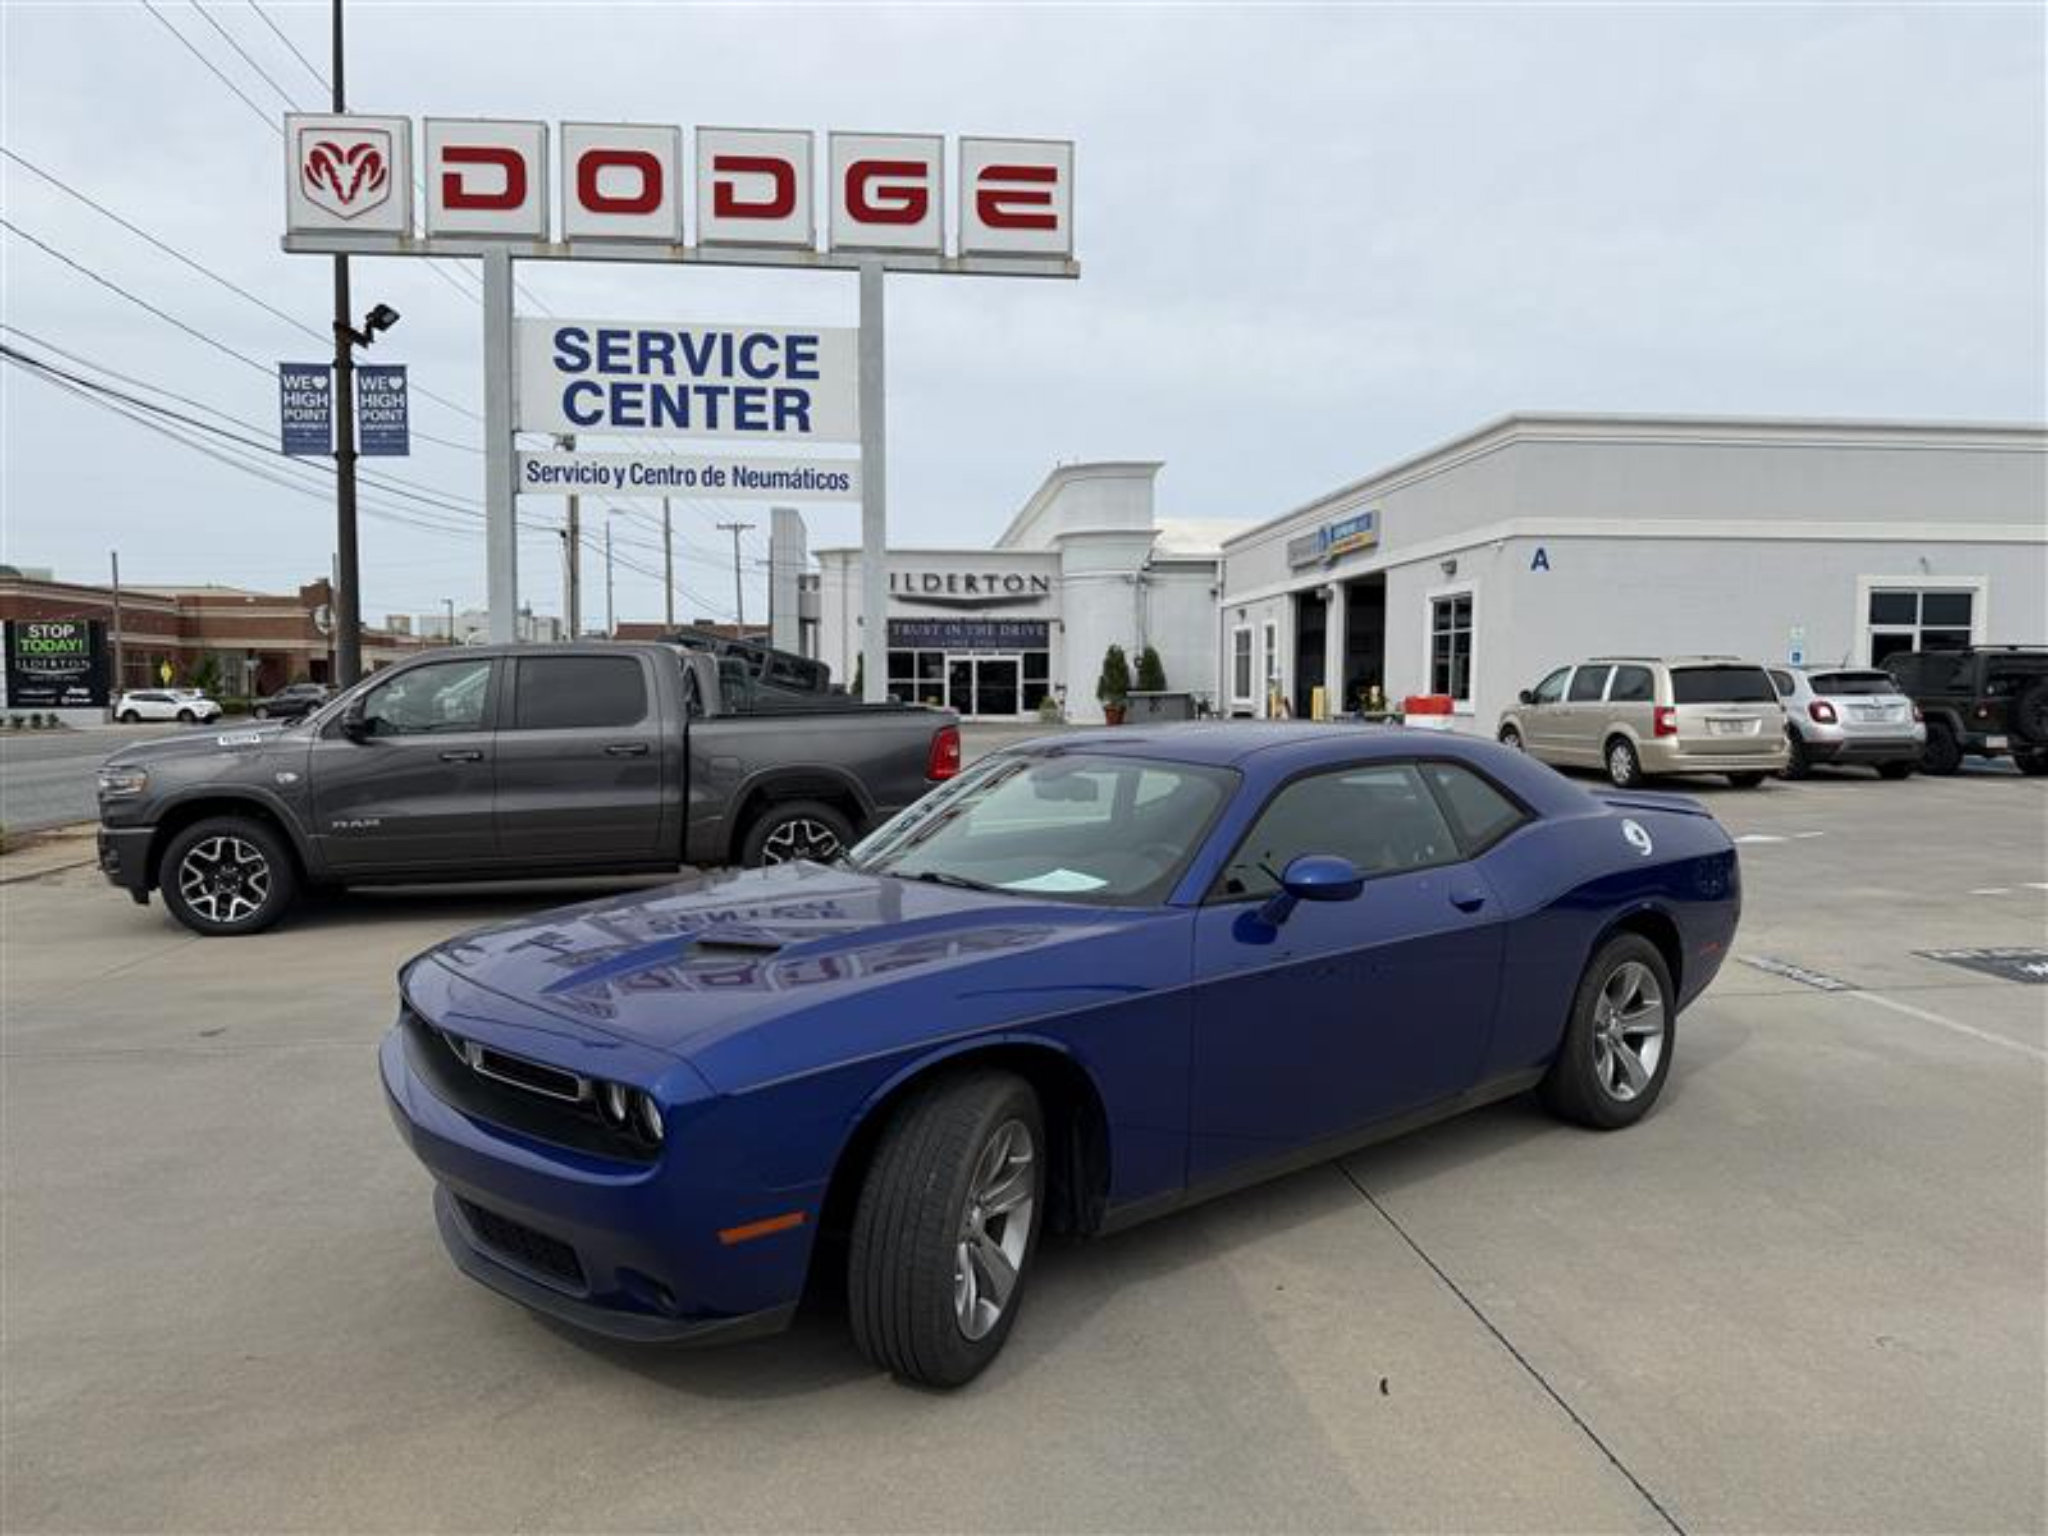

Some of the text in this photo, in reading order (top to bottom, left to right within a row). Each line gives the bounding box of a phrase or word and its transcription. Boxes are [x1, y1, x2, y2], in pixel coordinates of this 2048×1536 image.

[441, 145, 1058, 231] DODGE
[552, 326, 820, 380] SERVICE
[283, 375, 313, 390] WE
[360, 376, 388, 391] WE
[283, 391, 329, 408] HIGH
[360, 393, 406, 408] HIGH
[562, 380, 812, 433] CENTER
[283, 408, 328, 421] POINT
[361, 409, 405, 422] POINT
[526, 459, 850, 491] Servicio y Centro de Neumáticos
[1530, 547, 1551, 571] A
[889, 572, 1050, 593] ILDERTON
[28, 623, 76, 639] STOP
[893, 622, 1046, 637] TRUST IN THE DRIVE
[20, 638, 83, 653] TODAY!
